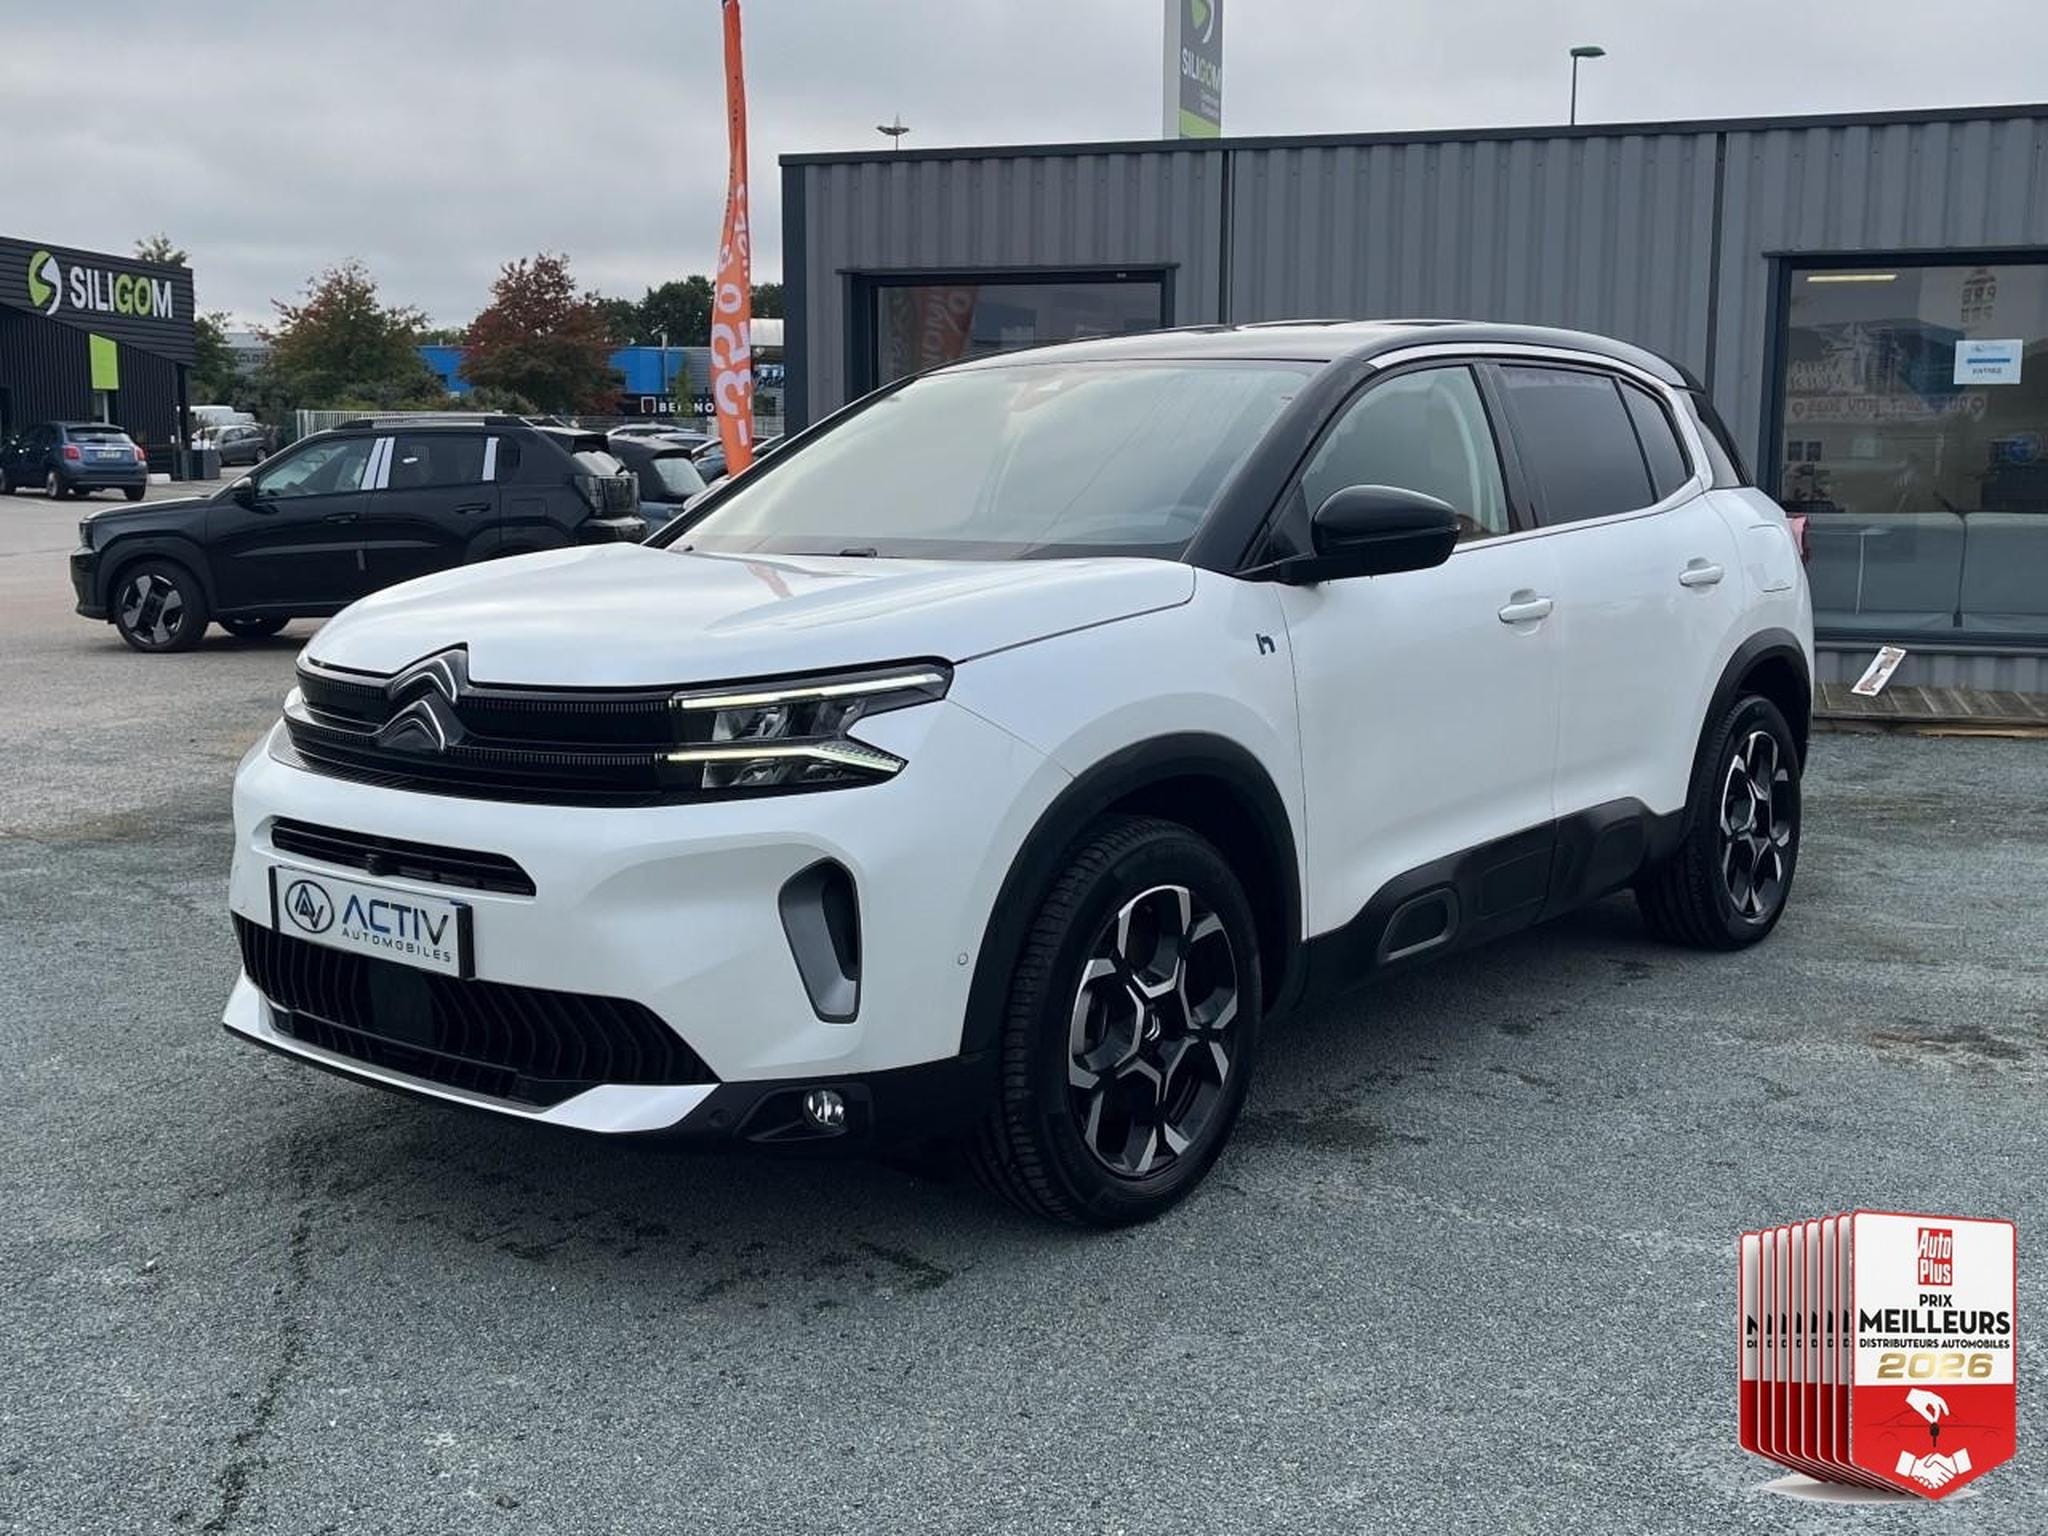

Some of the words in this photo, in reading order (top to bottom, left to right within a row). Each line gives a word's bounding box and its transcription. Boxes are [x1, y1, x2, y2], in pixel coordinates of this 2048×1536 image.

[1182, 47, 1221, 92] SILIGOM
[70, 266, 173, 319] SILIGOM
[342, 894, 448, 945] ACTIV
[342, 929, 452, 963] AUTOMOBILES
